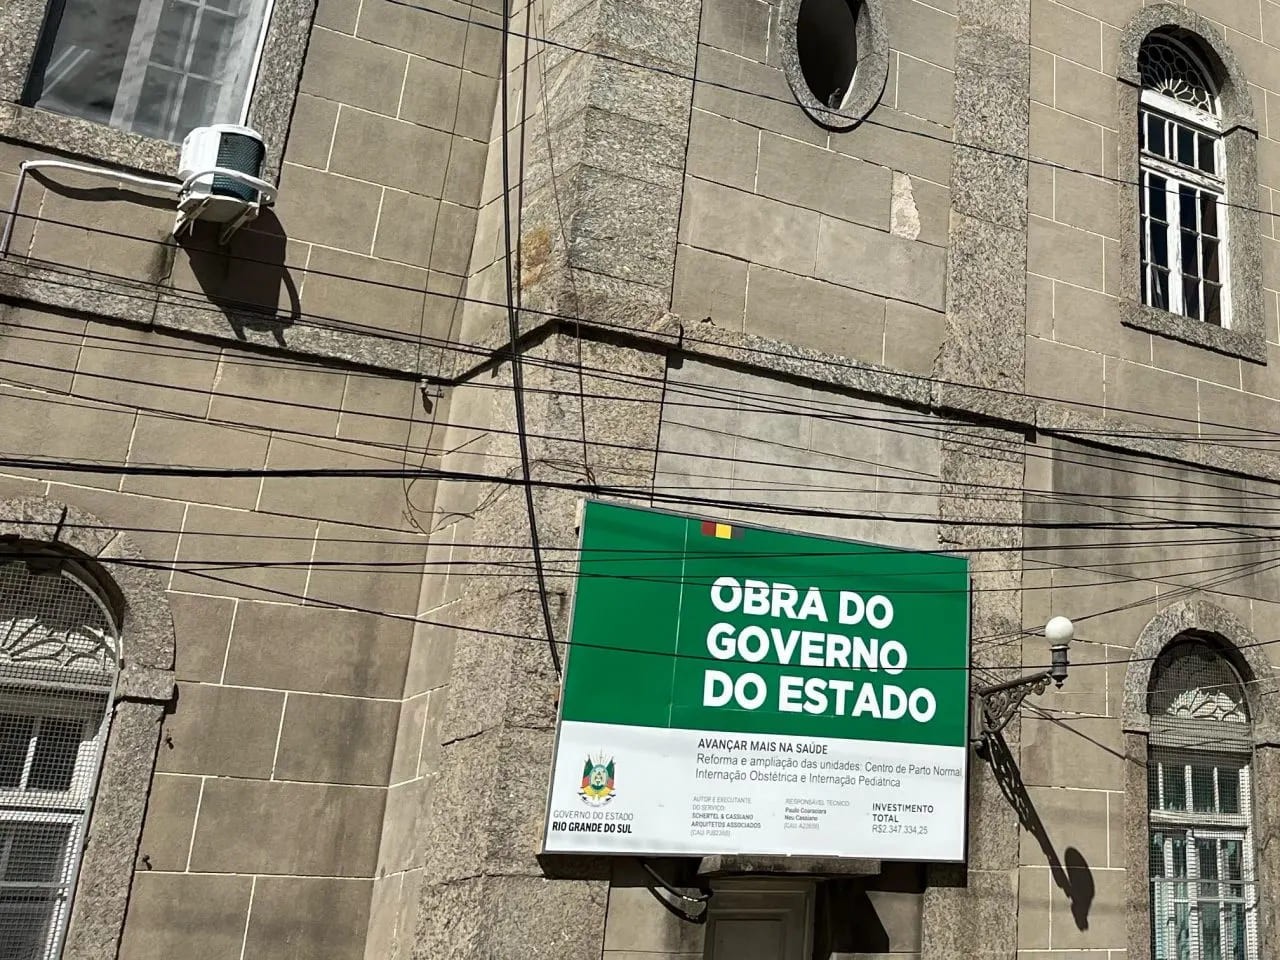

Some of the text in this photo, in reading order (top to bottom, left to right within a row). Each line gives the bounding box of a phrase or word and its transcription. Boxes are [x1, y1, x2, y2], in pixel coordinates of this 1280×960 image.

[710, 576, 894, 629] OBRA DO
[706, 622, 908, 675] GOVERNO
[703, 669, 937, 723] DO ESTADO
[697, 738, 828, 755] AVANÇAR MAIS NA SAÚDE
[696, 753, 738, 765] Reforma
[740, 758, 747, 766] e
[749, 757, 799, 769] ampliação
[800, 759, 818, 769] das
[864, 761, 893, 773] Centro
[895, 763, 906, 774] de
[908, 764, 931, 775] Parto
[695, 768, 747, 782] Internação
[749, 770, 798, 783] Obstétrica
[800, 774, 807, 783] e
[809, 773, 856, 787] Internação
[553, 810, 634, 821] GOVERNO DO ESTADO
[872, 802, 934, 813] INVESTIMENTO
[726, 821, 761, 829] ASSOCIADOS
[872, 813, 899, 823] TOTAL
[552, 821, 632, 834] RIO GRANDE DO SUL
